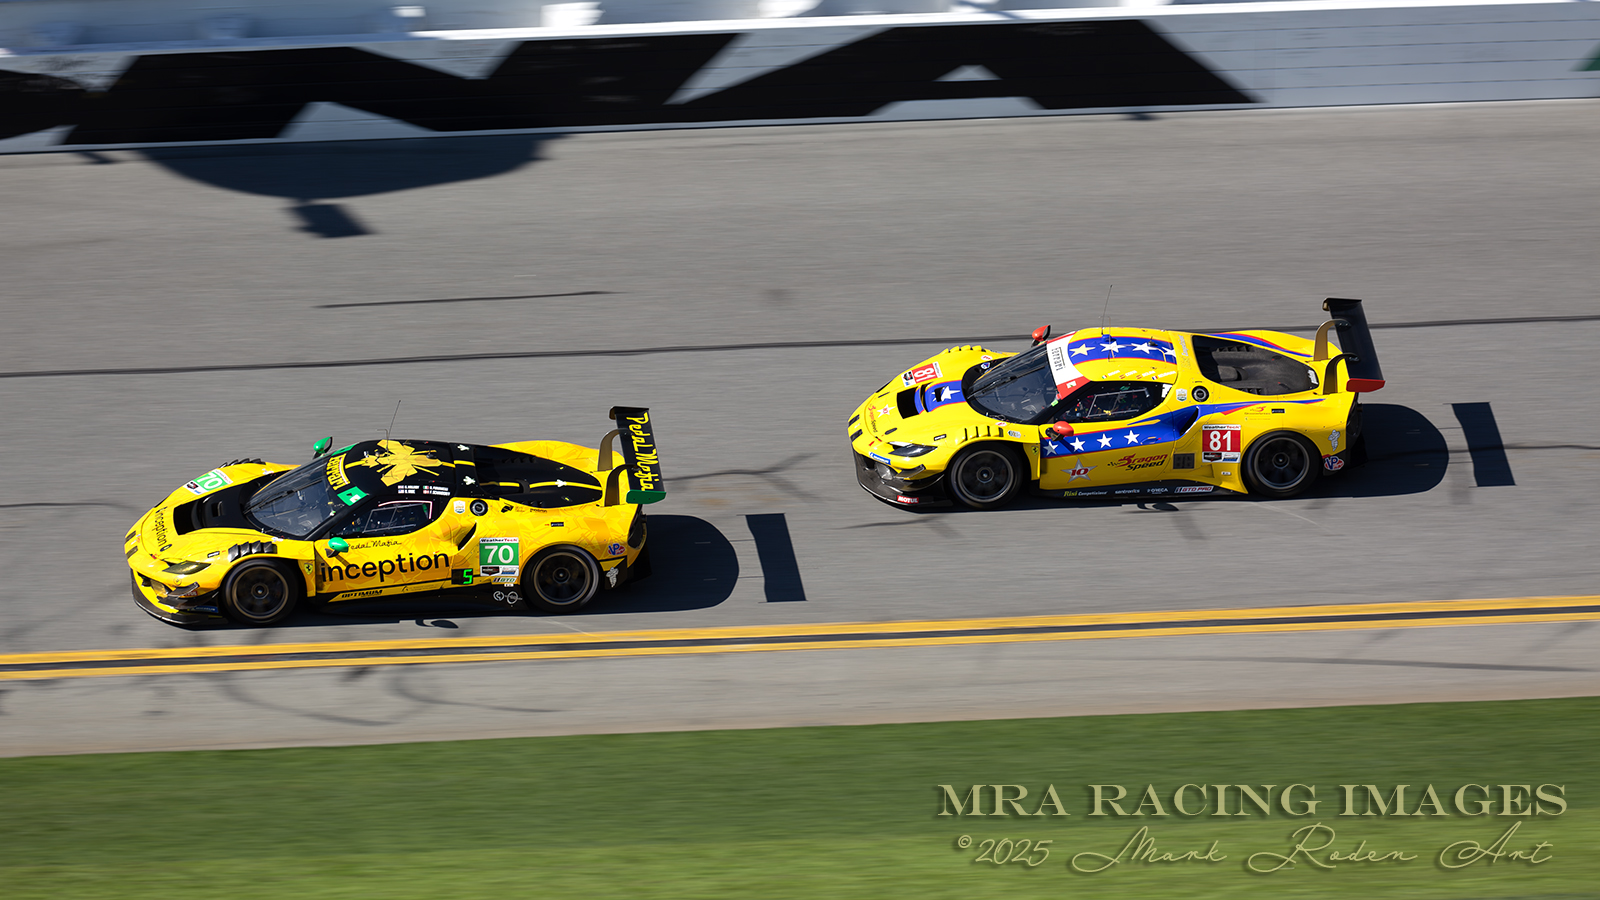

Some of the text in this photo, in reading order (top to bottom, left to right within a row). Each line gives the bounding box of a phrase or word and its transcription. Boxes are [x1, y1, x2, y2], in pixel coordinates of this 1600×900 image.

[914, 367, 936, 383] 81
[1209, 430, 1231, 451] 81
[634, 448, 660, 491] Mafia
[1070, 468, 1089, 476] 10
[1125, 460, 1165, 471] Speed
[197, 471, 223, 490] 70
[897, 495, 918, 503] MOTUL
[484, 544, 514, 564] 70
[320, 552, 450, 582] inception
[341, 589, 383, 599] OPTIMUM
